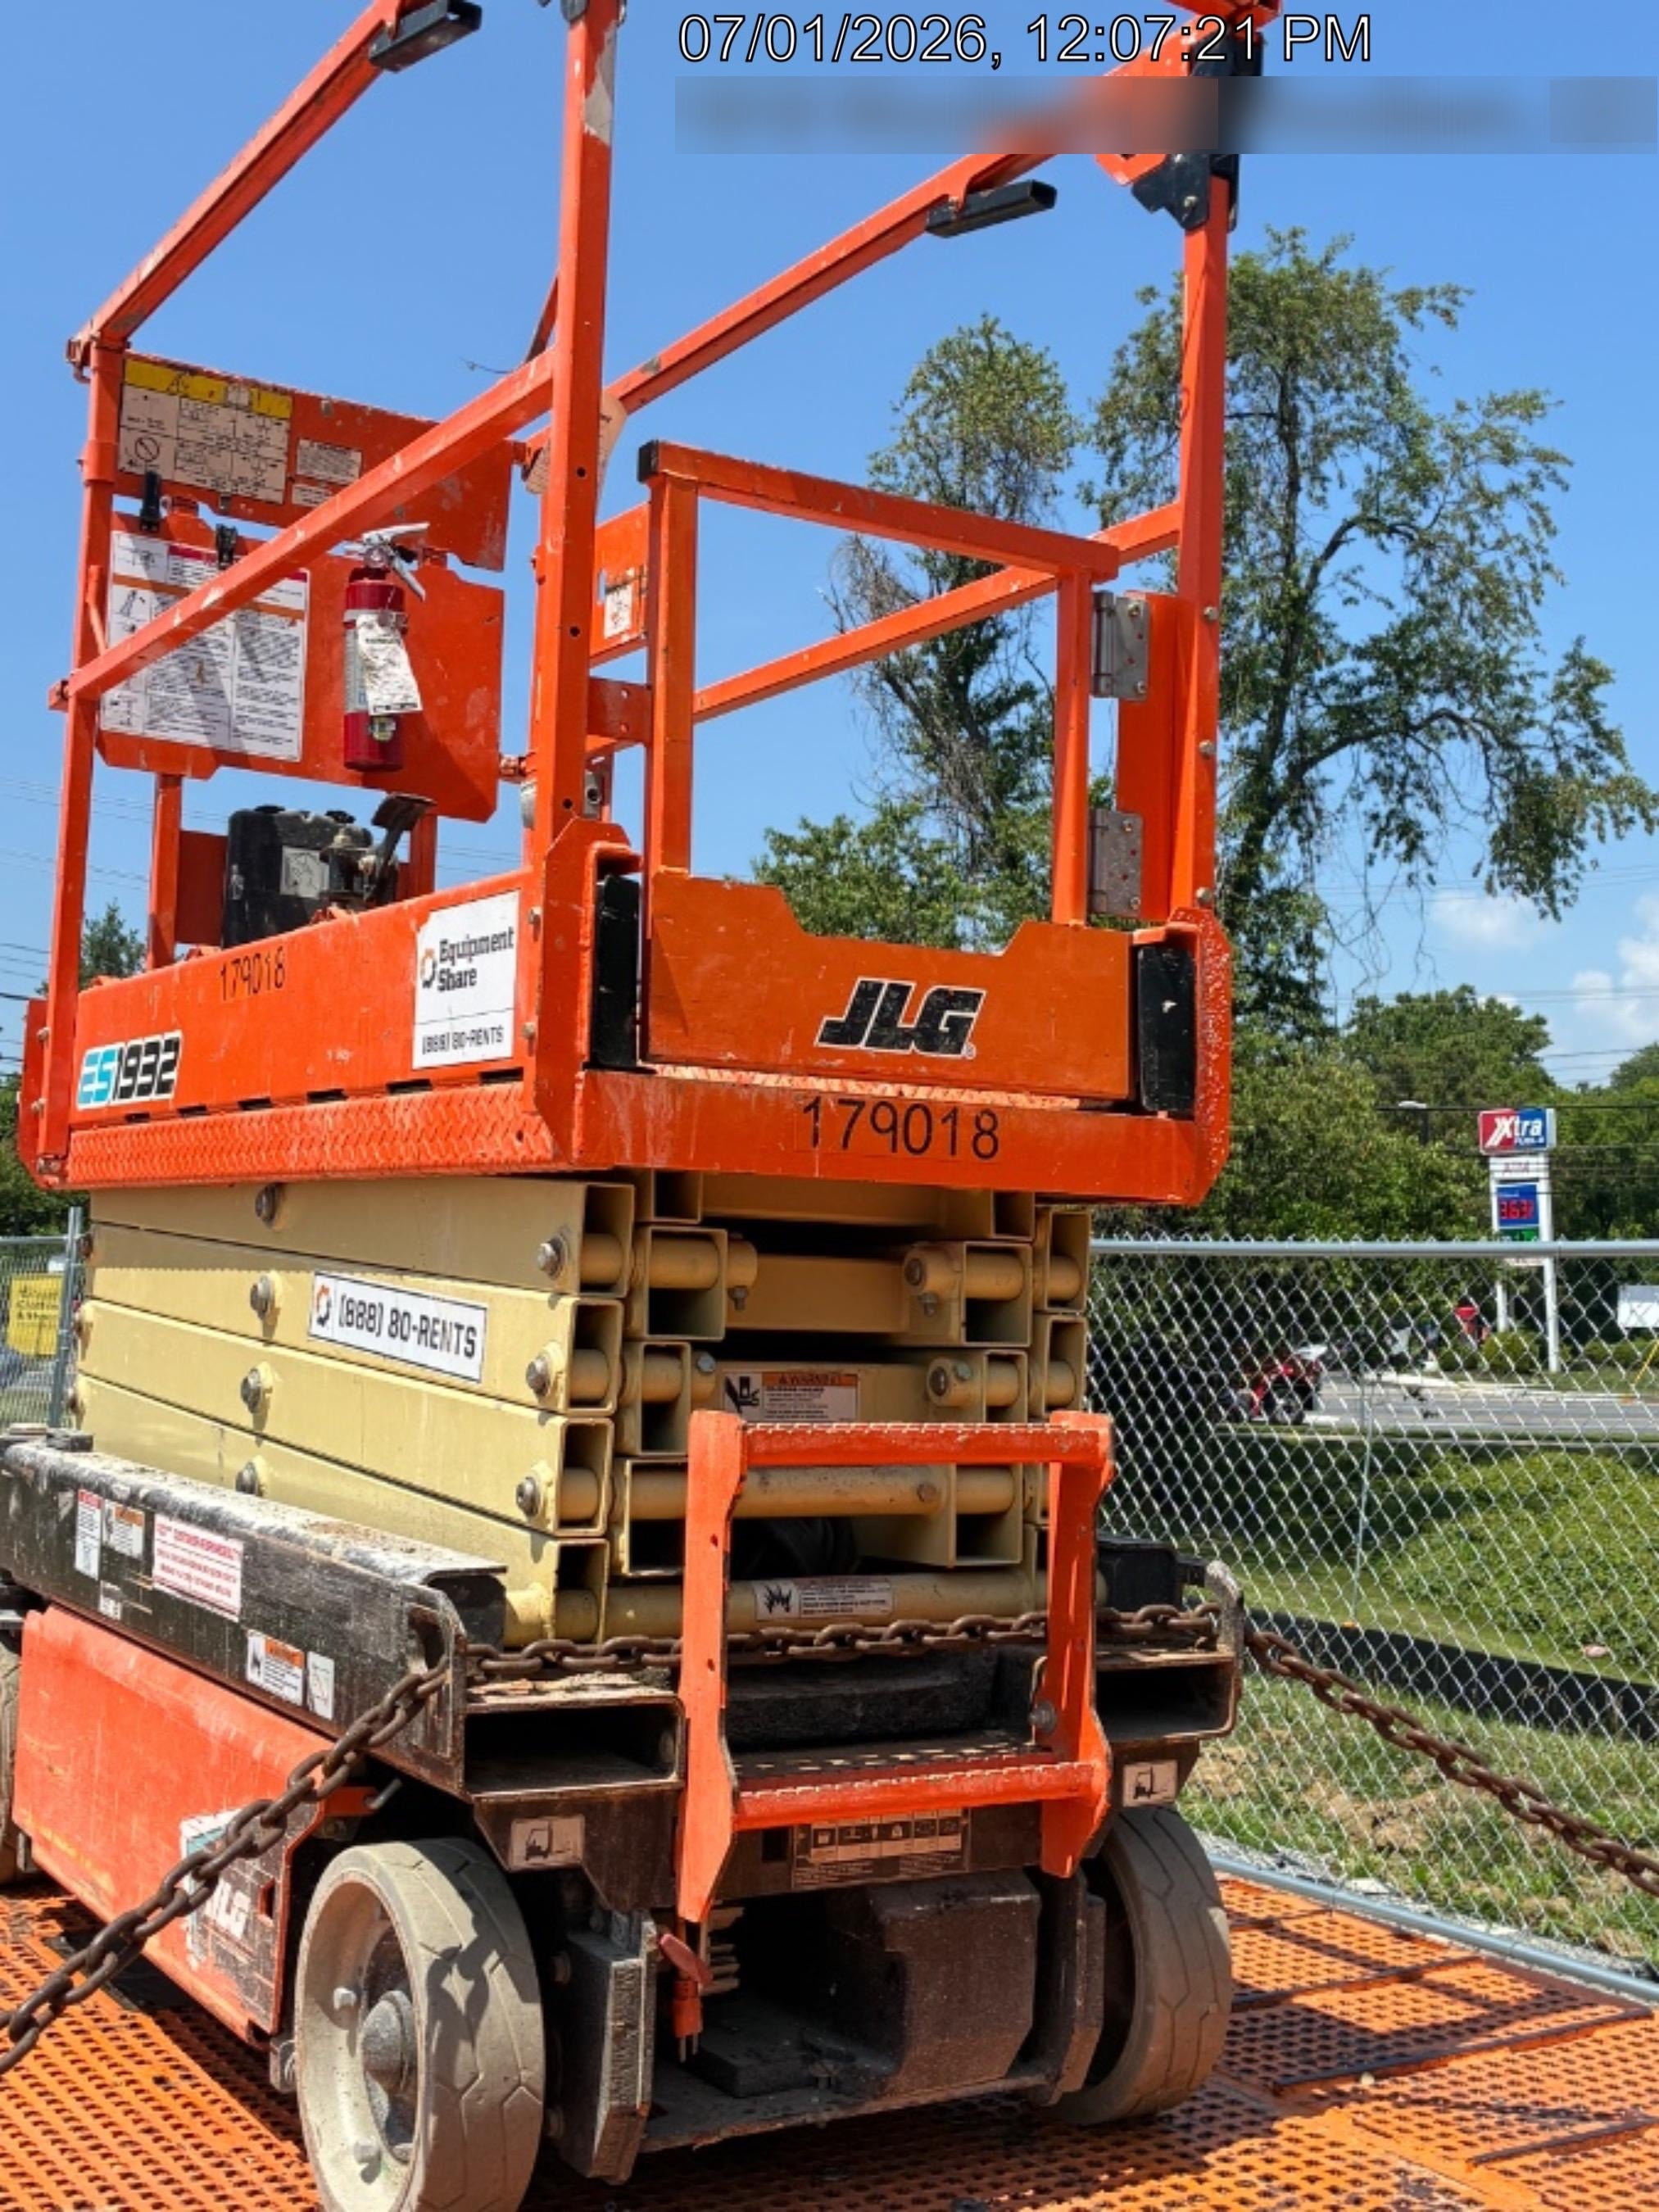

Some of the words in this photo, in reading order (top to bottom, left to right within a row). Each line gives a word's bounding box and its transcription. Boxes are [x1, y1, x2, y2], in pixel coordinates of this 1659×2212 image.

[220, 945, 285, 1001] 179018
[439, 927, 514, 967] Equipment
[437, 968, 477, 992] Share
[452, 1025, 504, 1050] 80-RENTS
[814, 977, 986, 1058] JLG
[77, 1031, 182, 1109] ES1932
[803, 1095, 999, 1160] 179018
[338, 1294, 384, 1337] (888)
[388, 1308, 477, 1359] 80-RENTS
